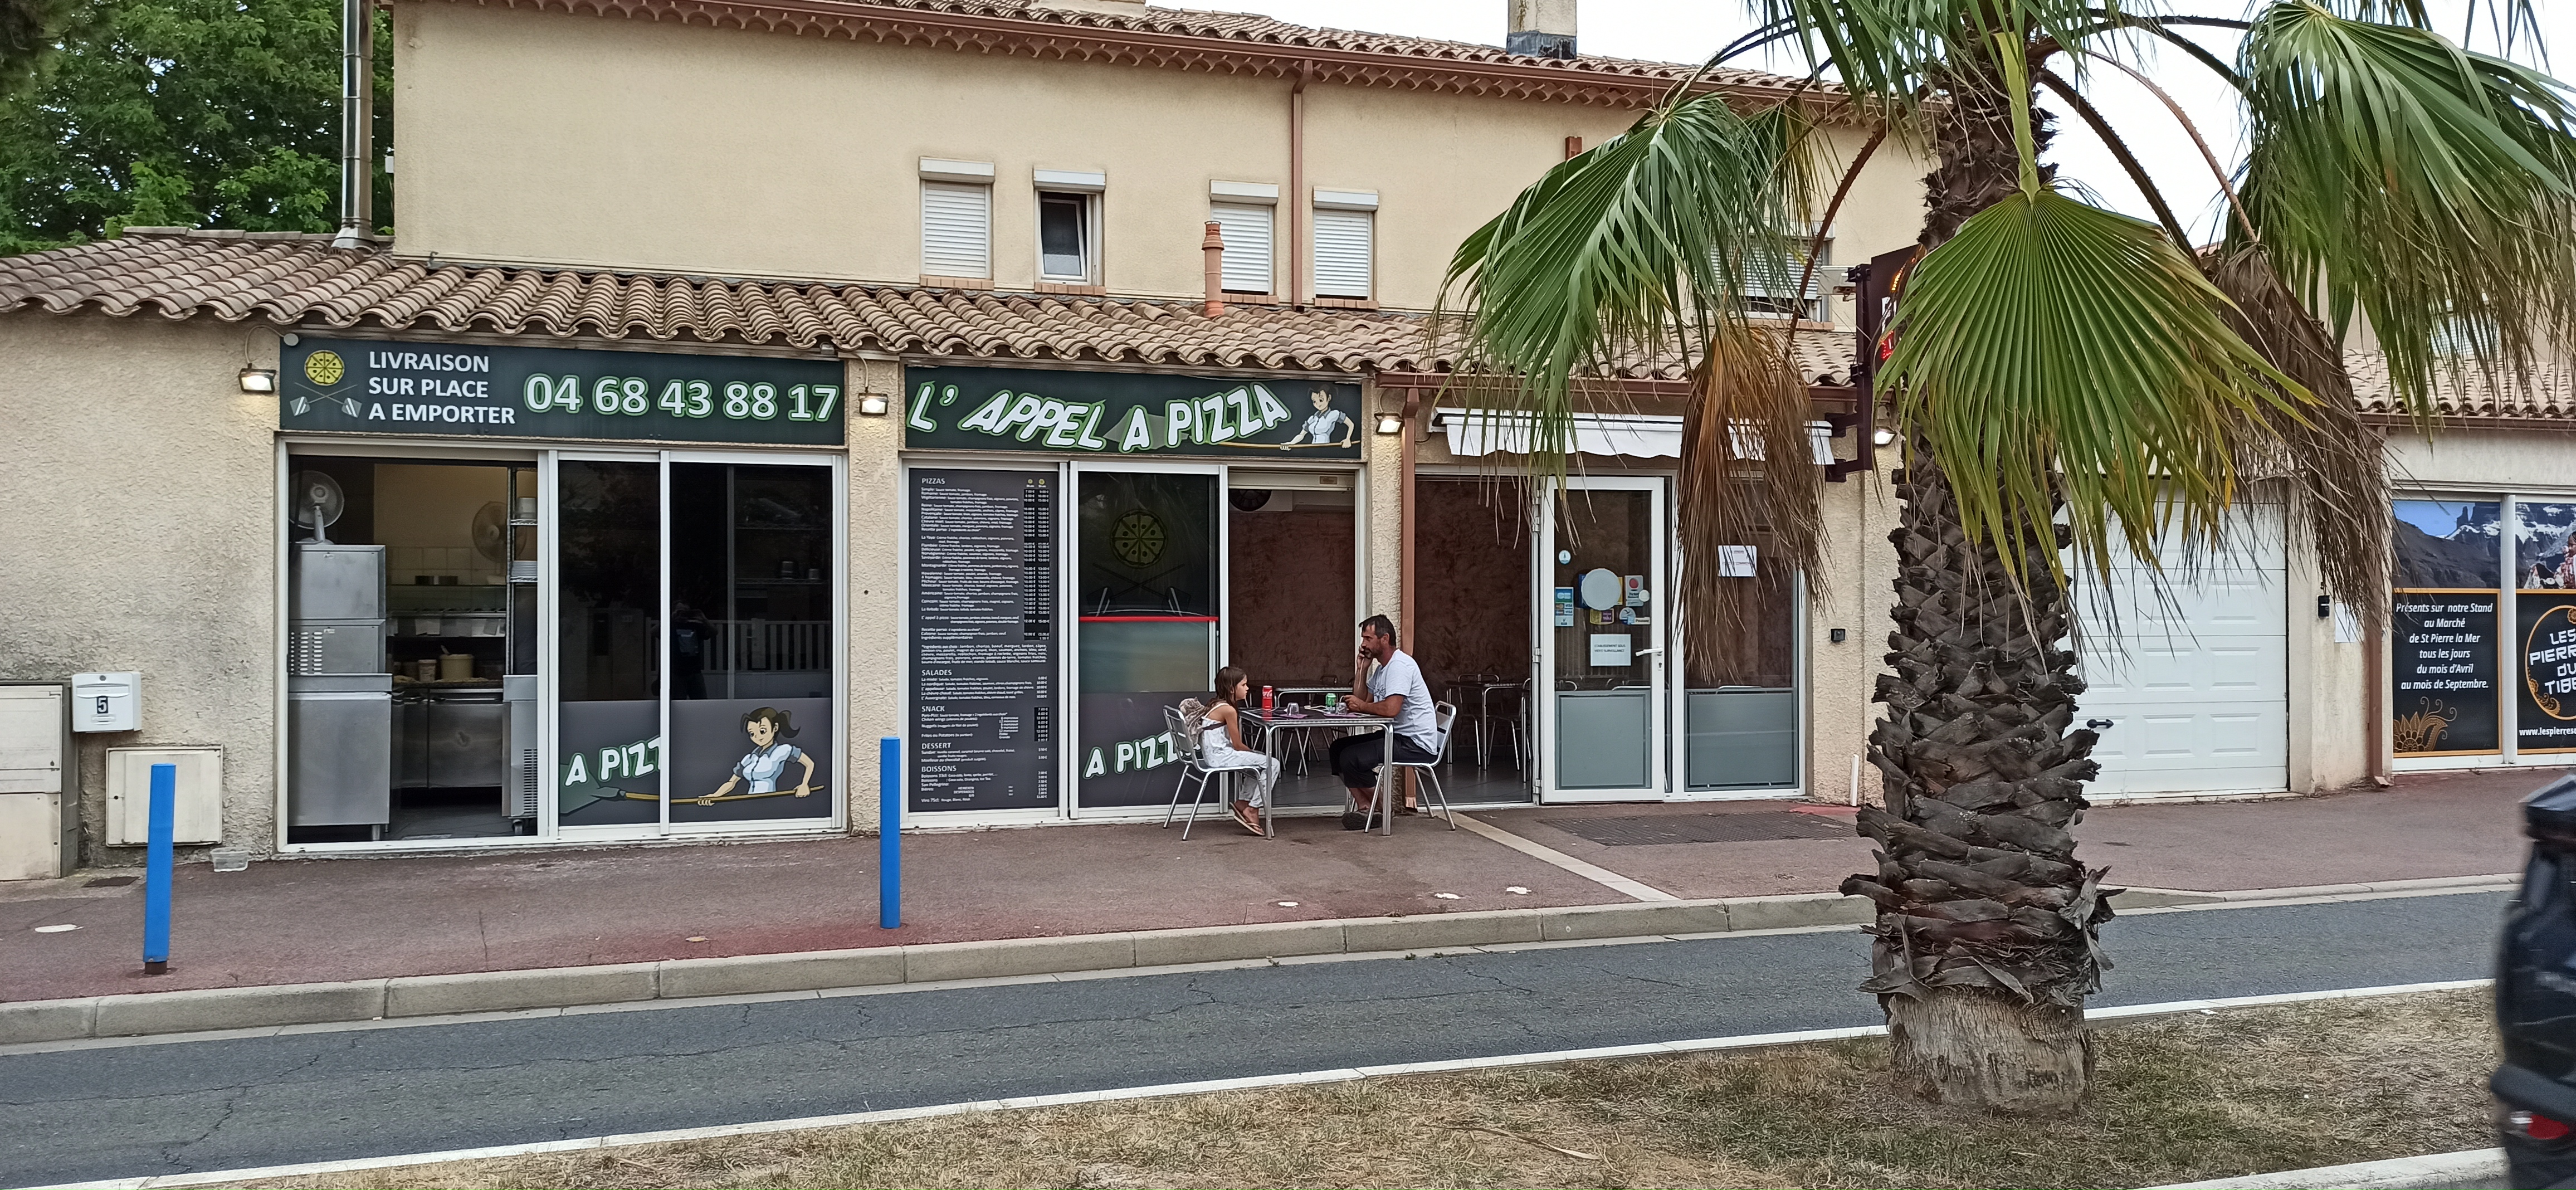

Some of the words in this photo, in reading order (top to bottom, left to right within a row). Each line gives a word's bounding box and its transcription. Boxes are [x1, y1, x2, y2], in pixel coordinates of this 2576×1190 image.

[369, 350, 489, 373] LIVRAISON
[369, 376, 415, 396] SUR
[421, 378, 489, 398] PLACE
[526, 375, 581, 411] 04
[594, 378, 647, 413] 68
[660, 381, 711, 416] 43
[725, 383, 775, 418] 88
[790, 386, 837, 420] 17
[368, 402, 386, 420] A
[392, 403, 515, 424] EMPORTER
[961, 392, 1103, 448] APPEL
[1121, 407, 1150, 451] A
[1167, 383, 1289, 446] PIZZA
[2448, 603, 2468, 613] notre
[2470, 603, 2493, 613] Stand
[2436, 617, 2466, 628] Marché
[2409, 633, 2419, 643] de
[2421, 633, 2429, 643] St
[2431, 633, 2454, 643] Pierre
[2455, 633, 2463, 643] la
[2465, 633, 2481, 643] Mer
[2549, 628, 2576, 645] LES
[2419, 650, 2437, 659] tous
[2438, 648, 2450, 659] les
[2449, 648, 2471, 661] jours
[2417, 664, 2427, 674] du
[2428, 664, 2448, 674] mois
[2449, 664, 2474, 674] d'Avril
[2413, 679, 2432, 690] mois
[2433, 679, 2444, 689] de
[2444, 679, 2489, 691] Septembre.
[97, 697, 108, 713] 5
[564, 754, 587, 787] A
[1085, 748, 1106, 778] A
